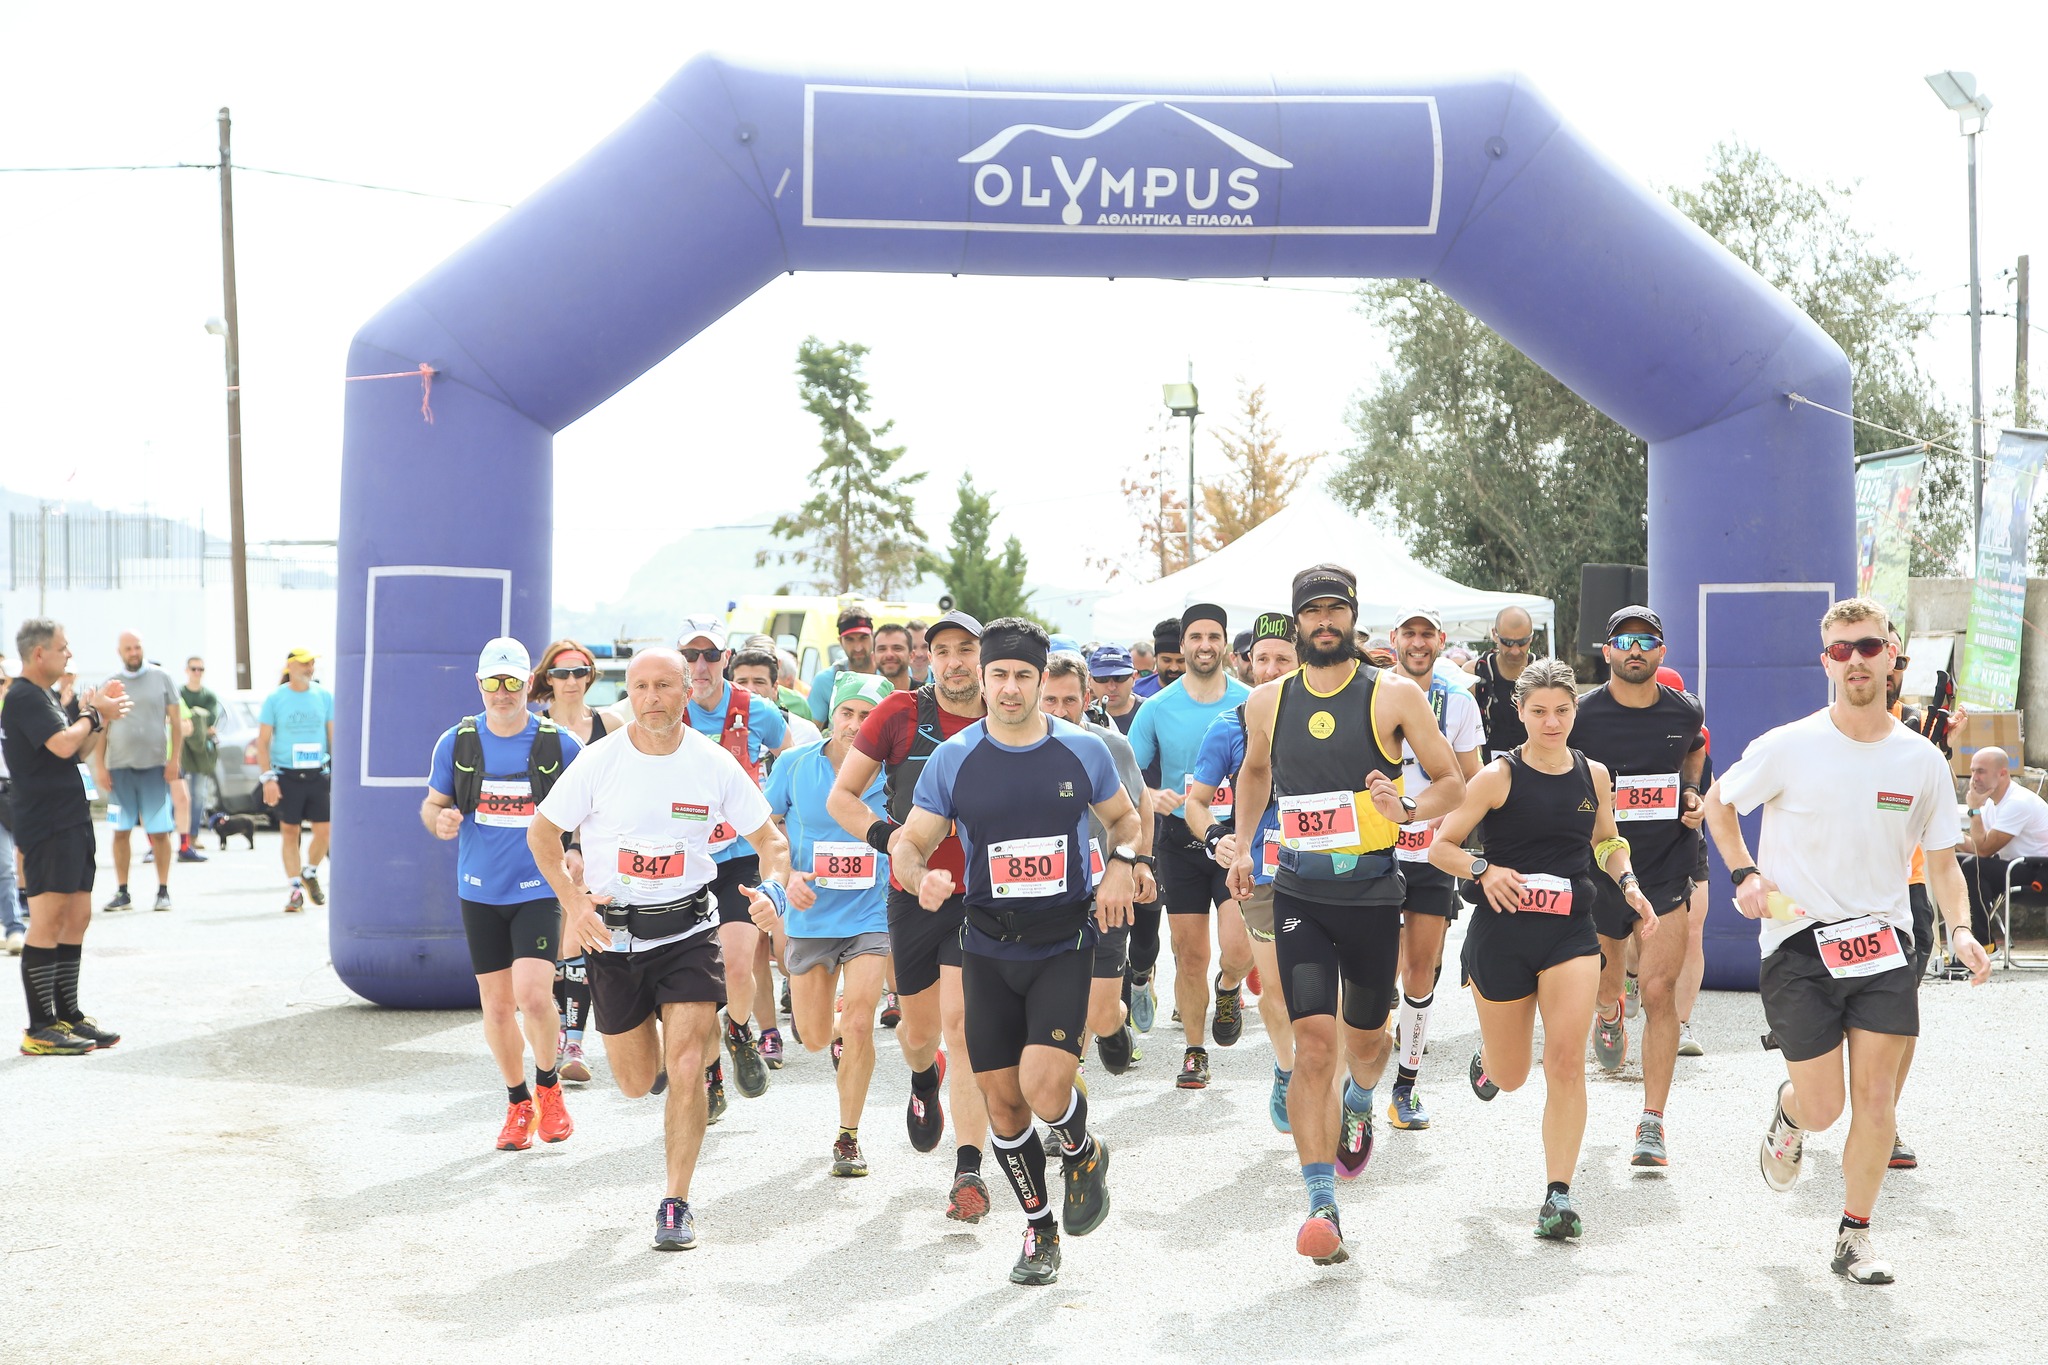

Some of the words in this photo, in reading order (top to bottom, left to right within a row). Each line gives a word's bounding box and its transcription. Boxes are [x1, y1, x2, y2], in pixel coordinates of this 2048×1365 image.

[974, 155, 1260, 225] OLYMPUS
[1097, 213, 1182, 226] ΑΘΛΗΤΙΚΑ
[1186, 214, 1254, 226] ΕΠΑΘΛΑ
[1629, 787, 1664, 805] 854
[1297, 809, 1337, 832] 837
[1397, 830, 1425, 848] 858
[632, 854, 671, 876] 847
[828, 856, 862, 874] 838
[1008, 855, 1052, 878] 850
[519, 879, 541, 890] ERGO
[1838, 933, 1882, 962] 805
